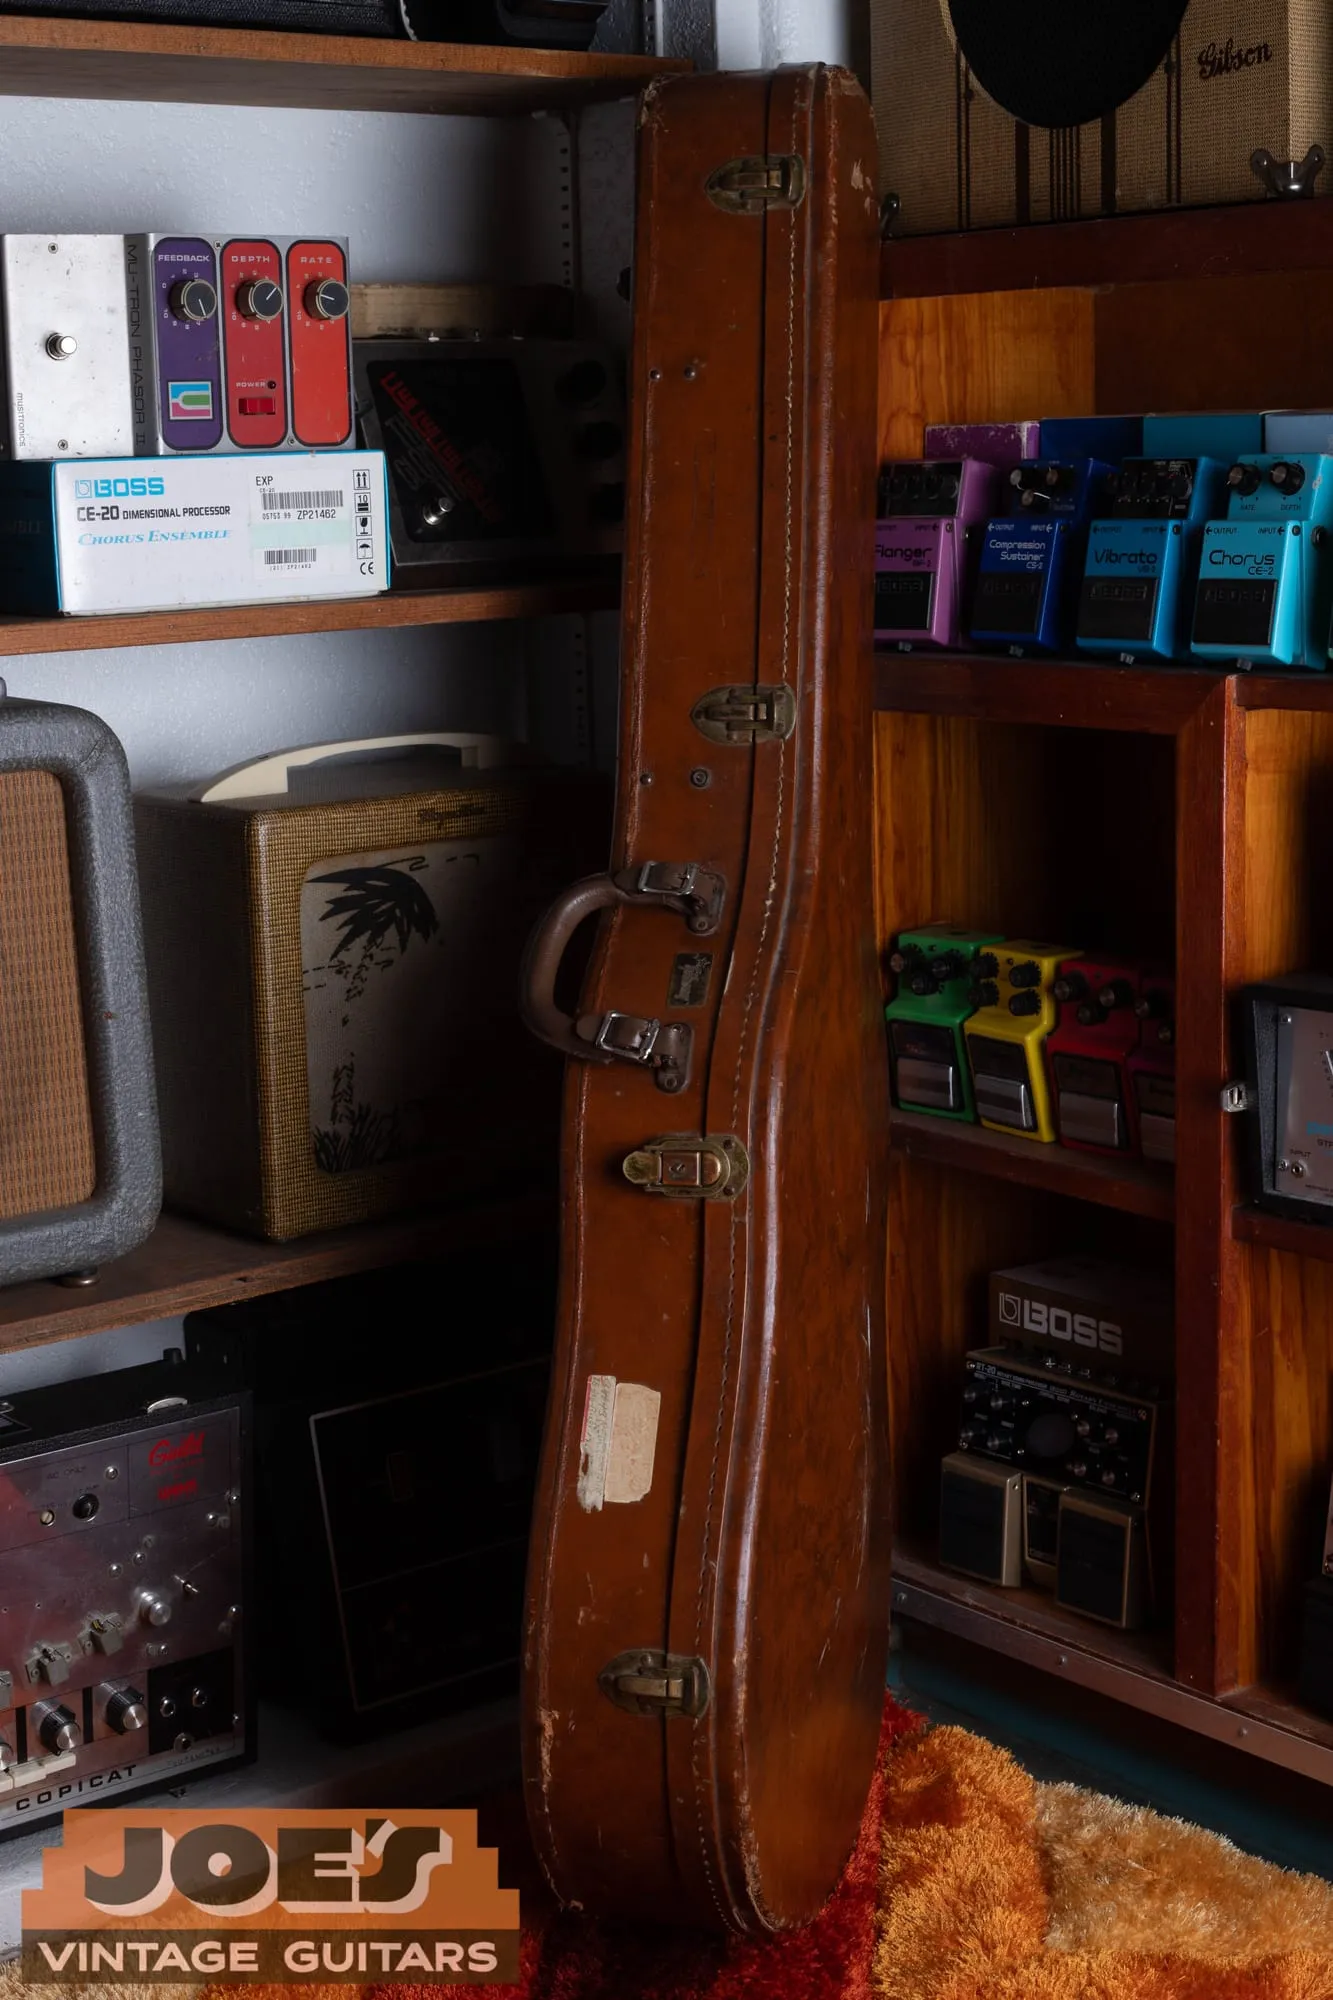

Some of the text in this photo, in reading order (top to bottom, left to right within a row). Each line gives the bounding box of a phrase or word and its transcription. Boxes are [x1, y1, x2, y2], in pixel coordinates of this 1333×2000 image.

[1198, 38, 1272, 79] Gibson
[158, 254, 210, 262] FEEDBACK
[231, 255, 270, 263] DEPTH
[300, 256, 333, 264] RATE
[127, 244, 141, 338] MU-TRON
[132, 346, 145, 425] PHASOR
[94, 477, 165, 498] BOSS
[255, 475, 274, 486] EXP
[358, 494, 368, 503] 10
[77, 505, 231, 522] CE-20 DIMENSIONAL PROCESSOR
[297, 509, 336, 520] ZP21462
[148, 529, 232, 543] ENSEMBLE
[989, 539, 1046, 551] Compression
[1000, 551, 1045, 561] Sustainer
[1093, 548, 1158, 565] Vibrato
[1208, 549, 1275, 566] Chorus
[1248, 566, 1274, 576] CE-2
[1023, 1298, 1123, 1356] BOSS
[16, 1764, 137, 1811] COPICAT
